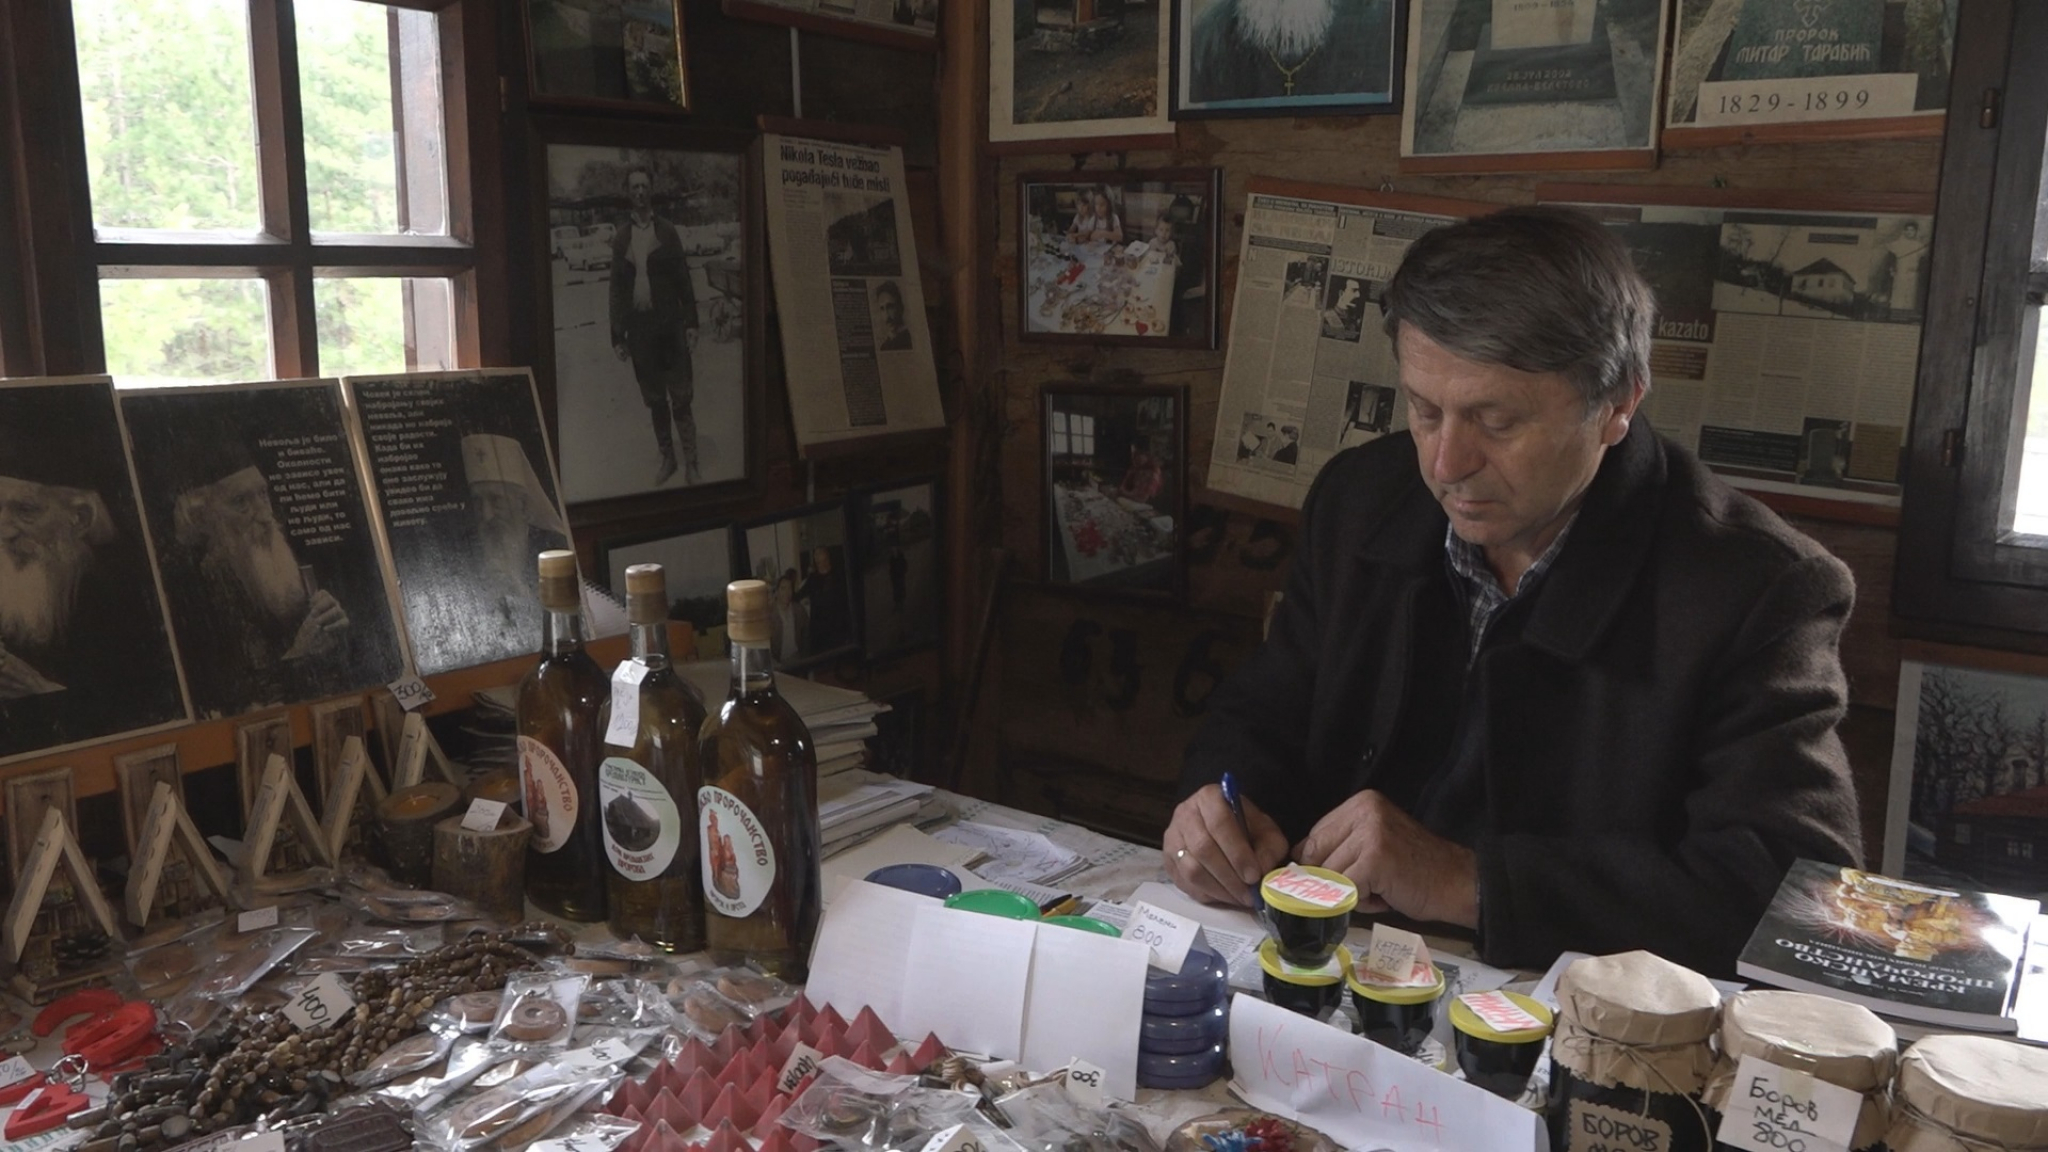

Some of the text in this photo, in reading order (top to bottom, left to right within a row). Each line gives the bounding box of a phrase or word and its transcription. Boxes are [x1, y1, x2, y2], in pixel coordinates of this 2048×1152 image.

[1775, 28, 1840, 41] ПРОРОК
[1737, 43, 1872, 63] МИТАР ТАРАБИЋ
[780, 144, 815, 165] Nikola
[818, 149, 844, 169] Tesla
[867, 177, 890, 192] misli
[713, 790, 768, 866] ПРОРОЧАНСТВО
[1132, 924, 1164, 947] 800
[1775, 938, 1995, 990] ПРОРОЧАНСТВО
[1794, 952, 1966, 995] КРЕМАНСКО
[1258, 1023, 1447, 1145] КАТРАН
[1582, 1112, 1660, 1152] БОРОВ
[1752, 1121, 1807, 1152] 800
